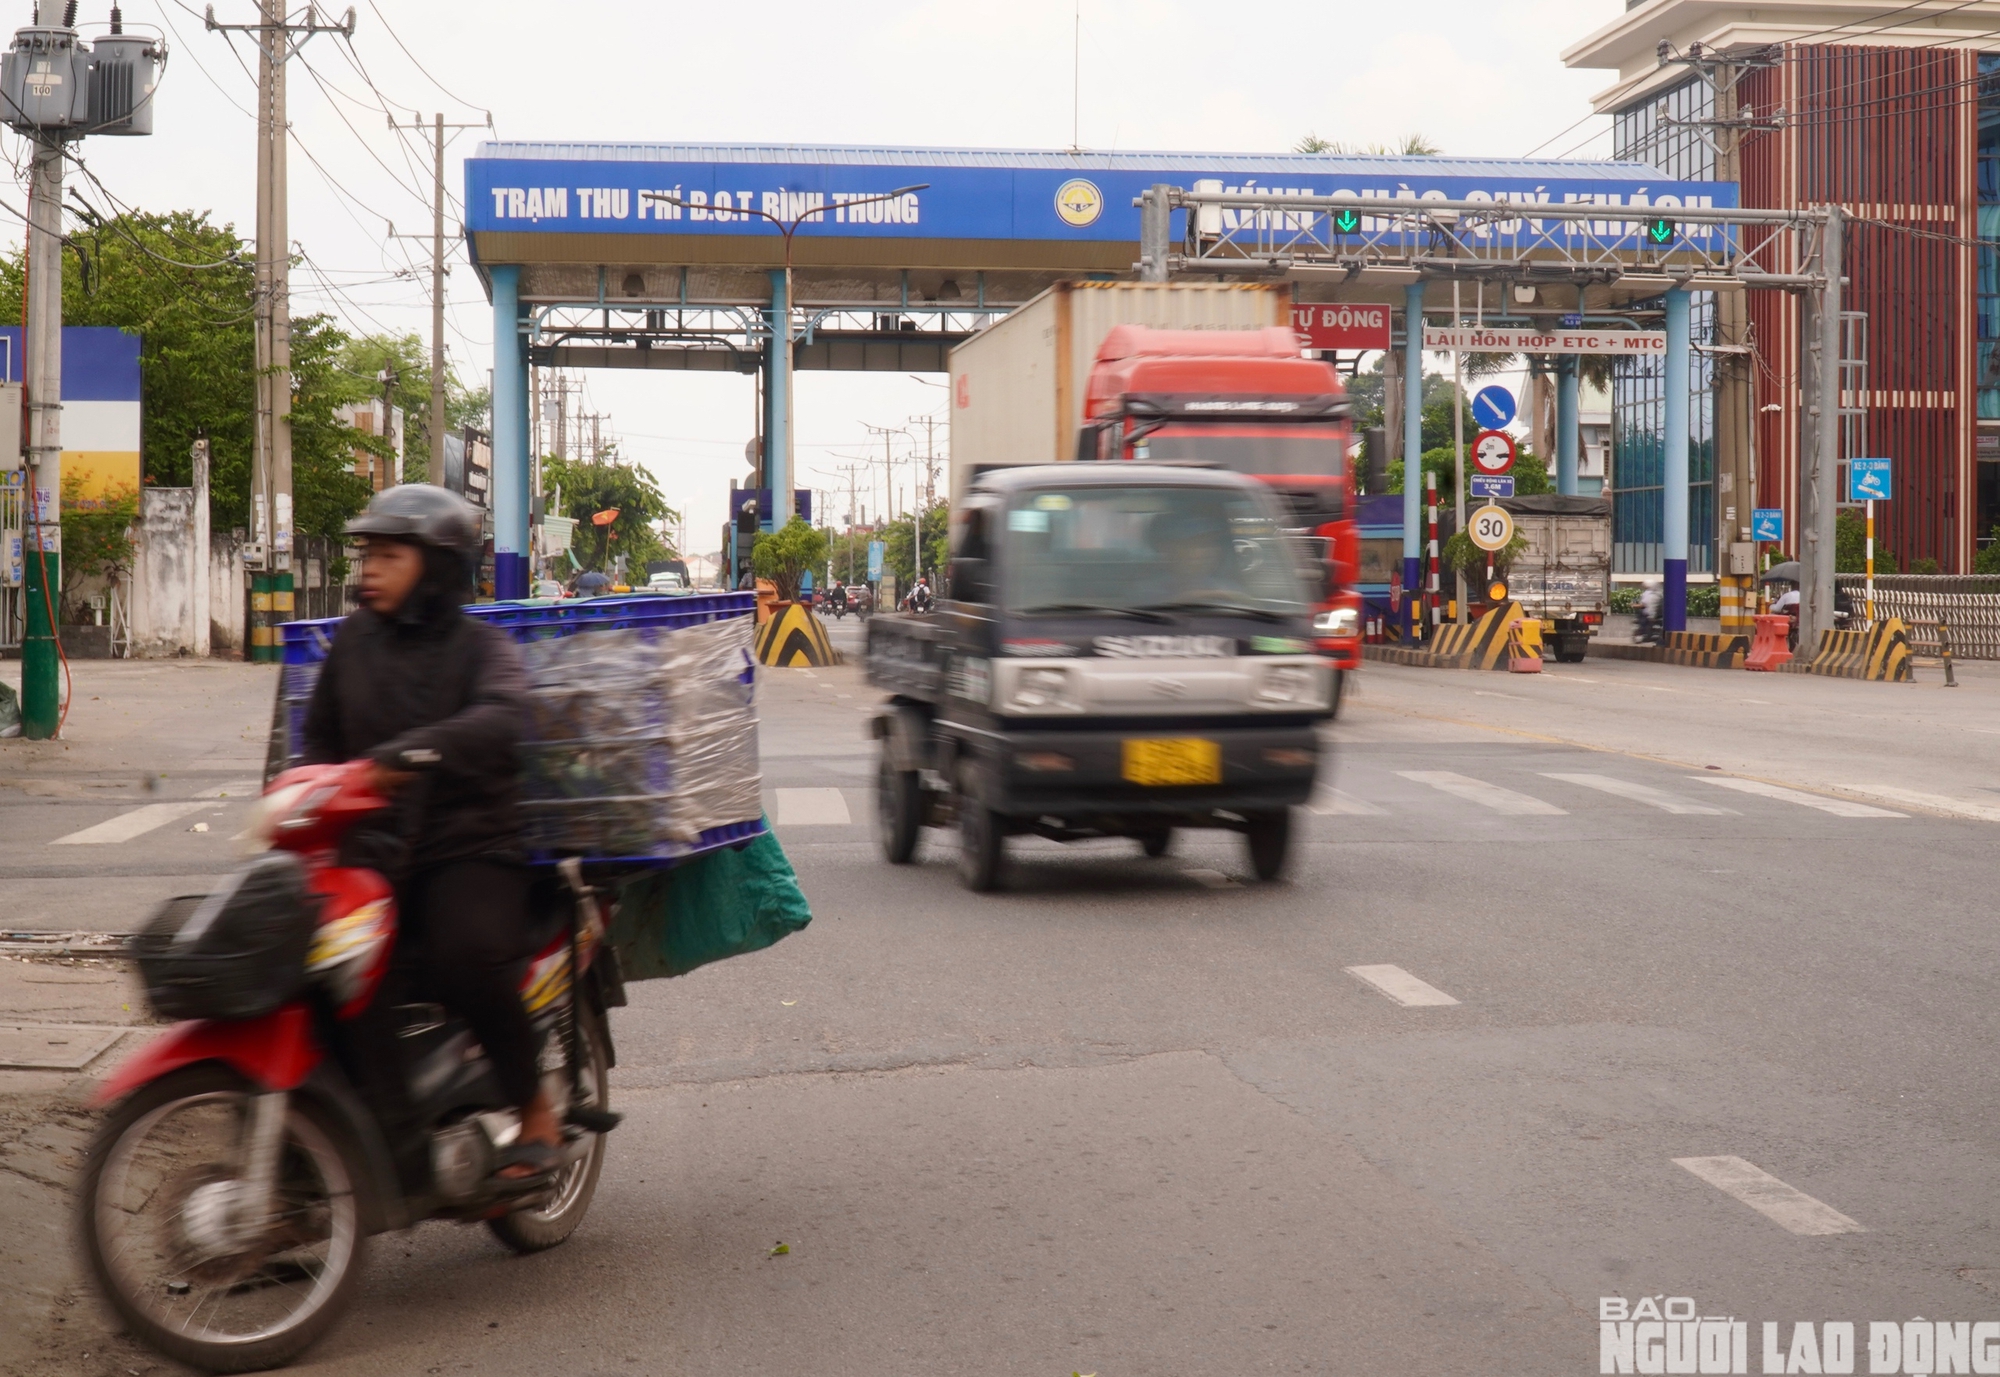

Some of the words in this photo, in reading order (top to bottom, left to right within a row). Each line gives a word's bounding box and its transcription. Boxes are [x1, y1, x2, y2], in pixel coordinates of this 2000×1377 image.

[34, 86, 50, 94] 100
[491, 187, 567, 222] TRẠM
[576, 188, 629, 219] THU
[638, 184, 682, 220] PHÍ
[690, 190, 753, 222] B.O.T
[762, 186, 824, 222] BÌNH
[832, 191, 919, 223] THUNG
[1288, 306, 1315, 331] TỰ
[1322, 305, 1383, 331] ĐỘNG
[1470, 330, 1510, 346] HỖN
[1518, 334, 1557, 350] HỢP
[1563, 336, 1599, 348] ETC
[1605, 339, 1617, 347] +
[1624, 338, 1664, 349] MTC
[1479, 518, 1503, 538] 30
